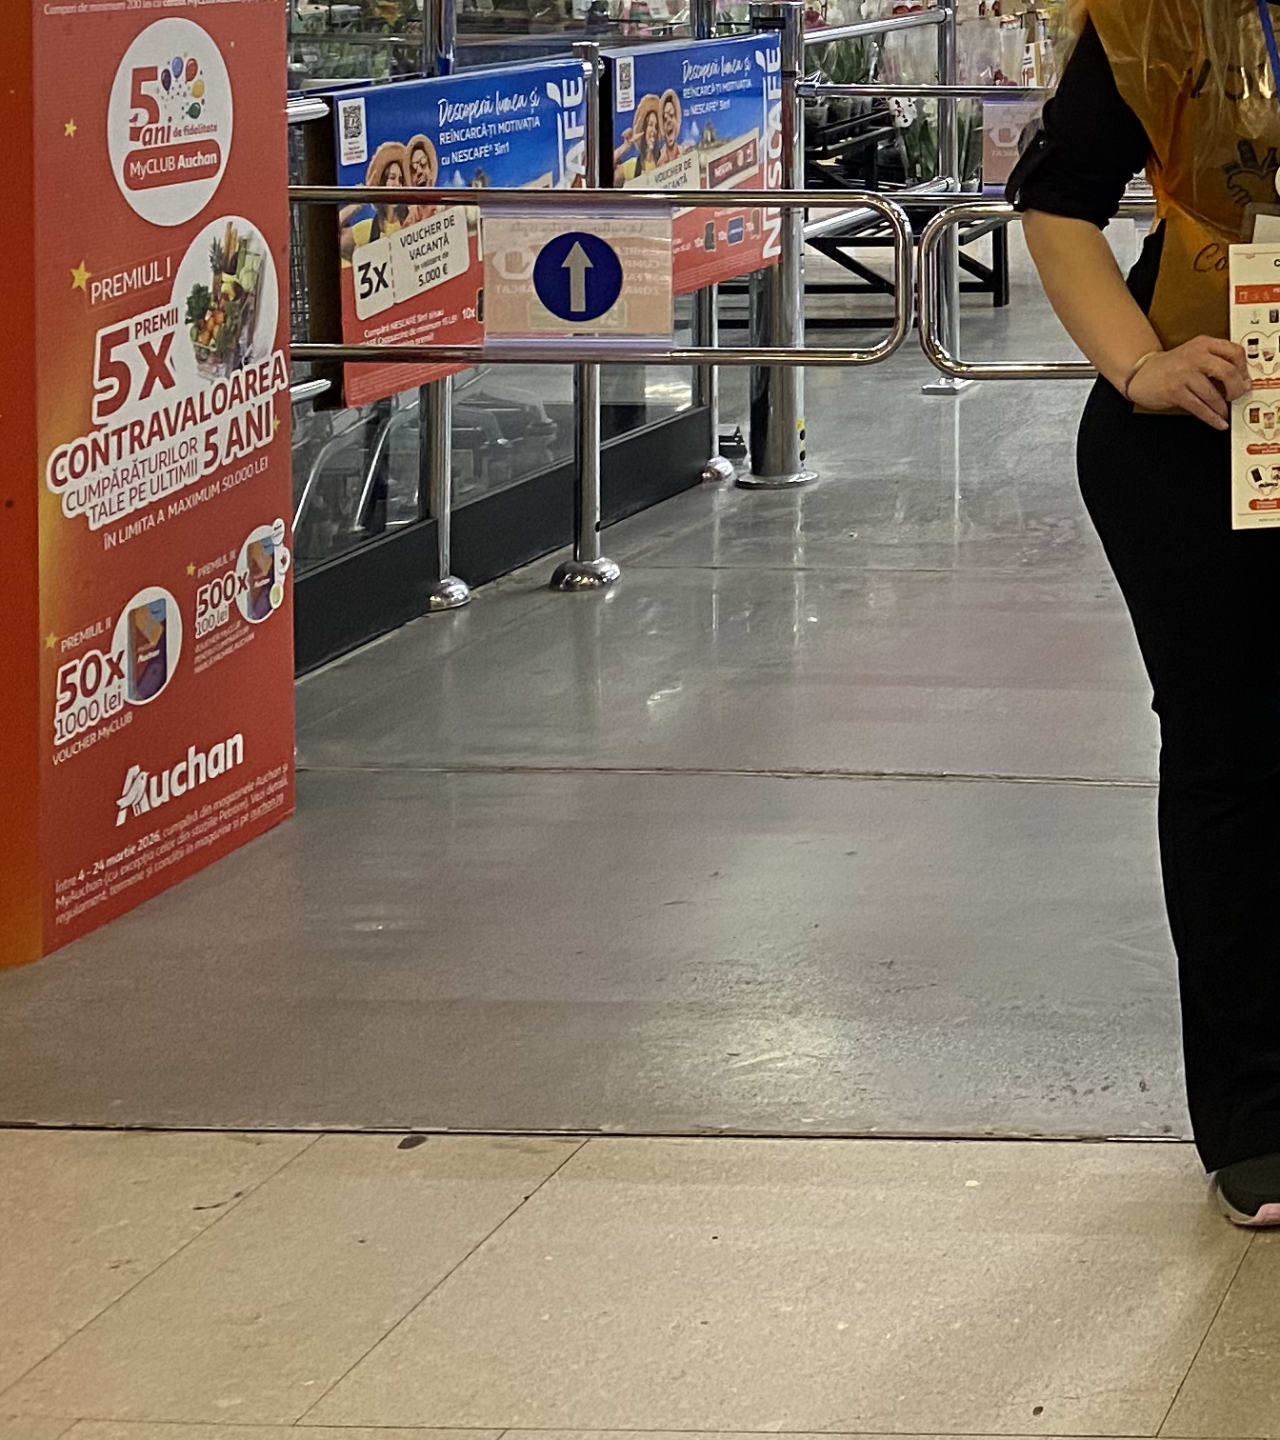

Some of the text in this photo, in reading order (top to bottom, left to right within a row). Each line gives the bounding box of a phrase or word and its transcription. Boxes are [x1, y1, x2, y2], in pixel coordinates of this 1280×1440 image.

[129, 66, 160, 142] 5
[438, 95, 494, 127] Descoperă
[142, 116, 172, 147] ani
[498, 115, 541, 134] MOTIVAȚIA
[130, 151, 217, 180] MyCLUB Auchan
[441, 141, 510, 166] cu 3in1
[655, 158, 692, 184] VOUCHER DE
[756, 47, 783, 259] NSCAFÉ
[400, 215, 456, 248] VOUCHER DE
[409, 233, 450, 261] VACANȚĂ
[91, 259, 163, 305] PREMIUL
[357, 261, 389, 300] 3x
[134, 307, 179, 341] PREMII
[50, 356, 287, 488] CONTRAVALOAREA
[66, 437, 199, 512] CUMPĂRĂTURILOR
[89, 401, 272, 525] TALE PE ULTIMII 5 ANI
[103, 530, 117, 551] ÎN
[118, 514, 156, 546] LIMITA
[157, 509, 166, 524] A
[168, 485, 221, 521] MAXIMUM
[255, 456, 270, 477] LEI
[198, 571, 249, 619] 500x
[61, 621, 102, 653] PREMIUL
[197, 605, 228, 636] 100 lei
[59, 649, 125, 713] 50x
[57, 684, 122, 741] 1000 lei
[52, 711, 133, 766] VOUCHER MyCLUB
[116, 732, 244, 827] Auchan
[106, 844, 136, 867] martie
